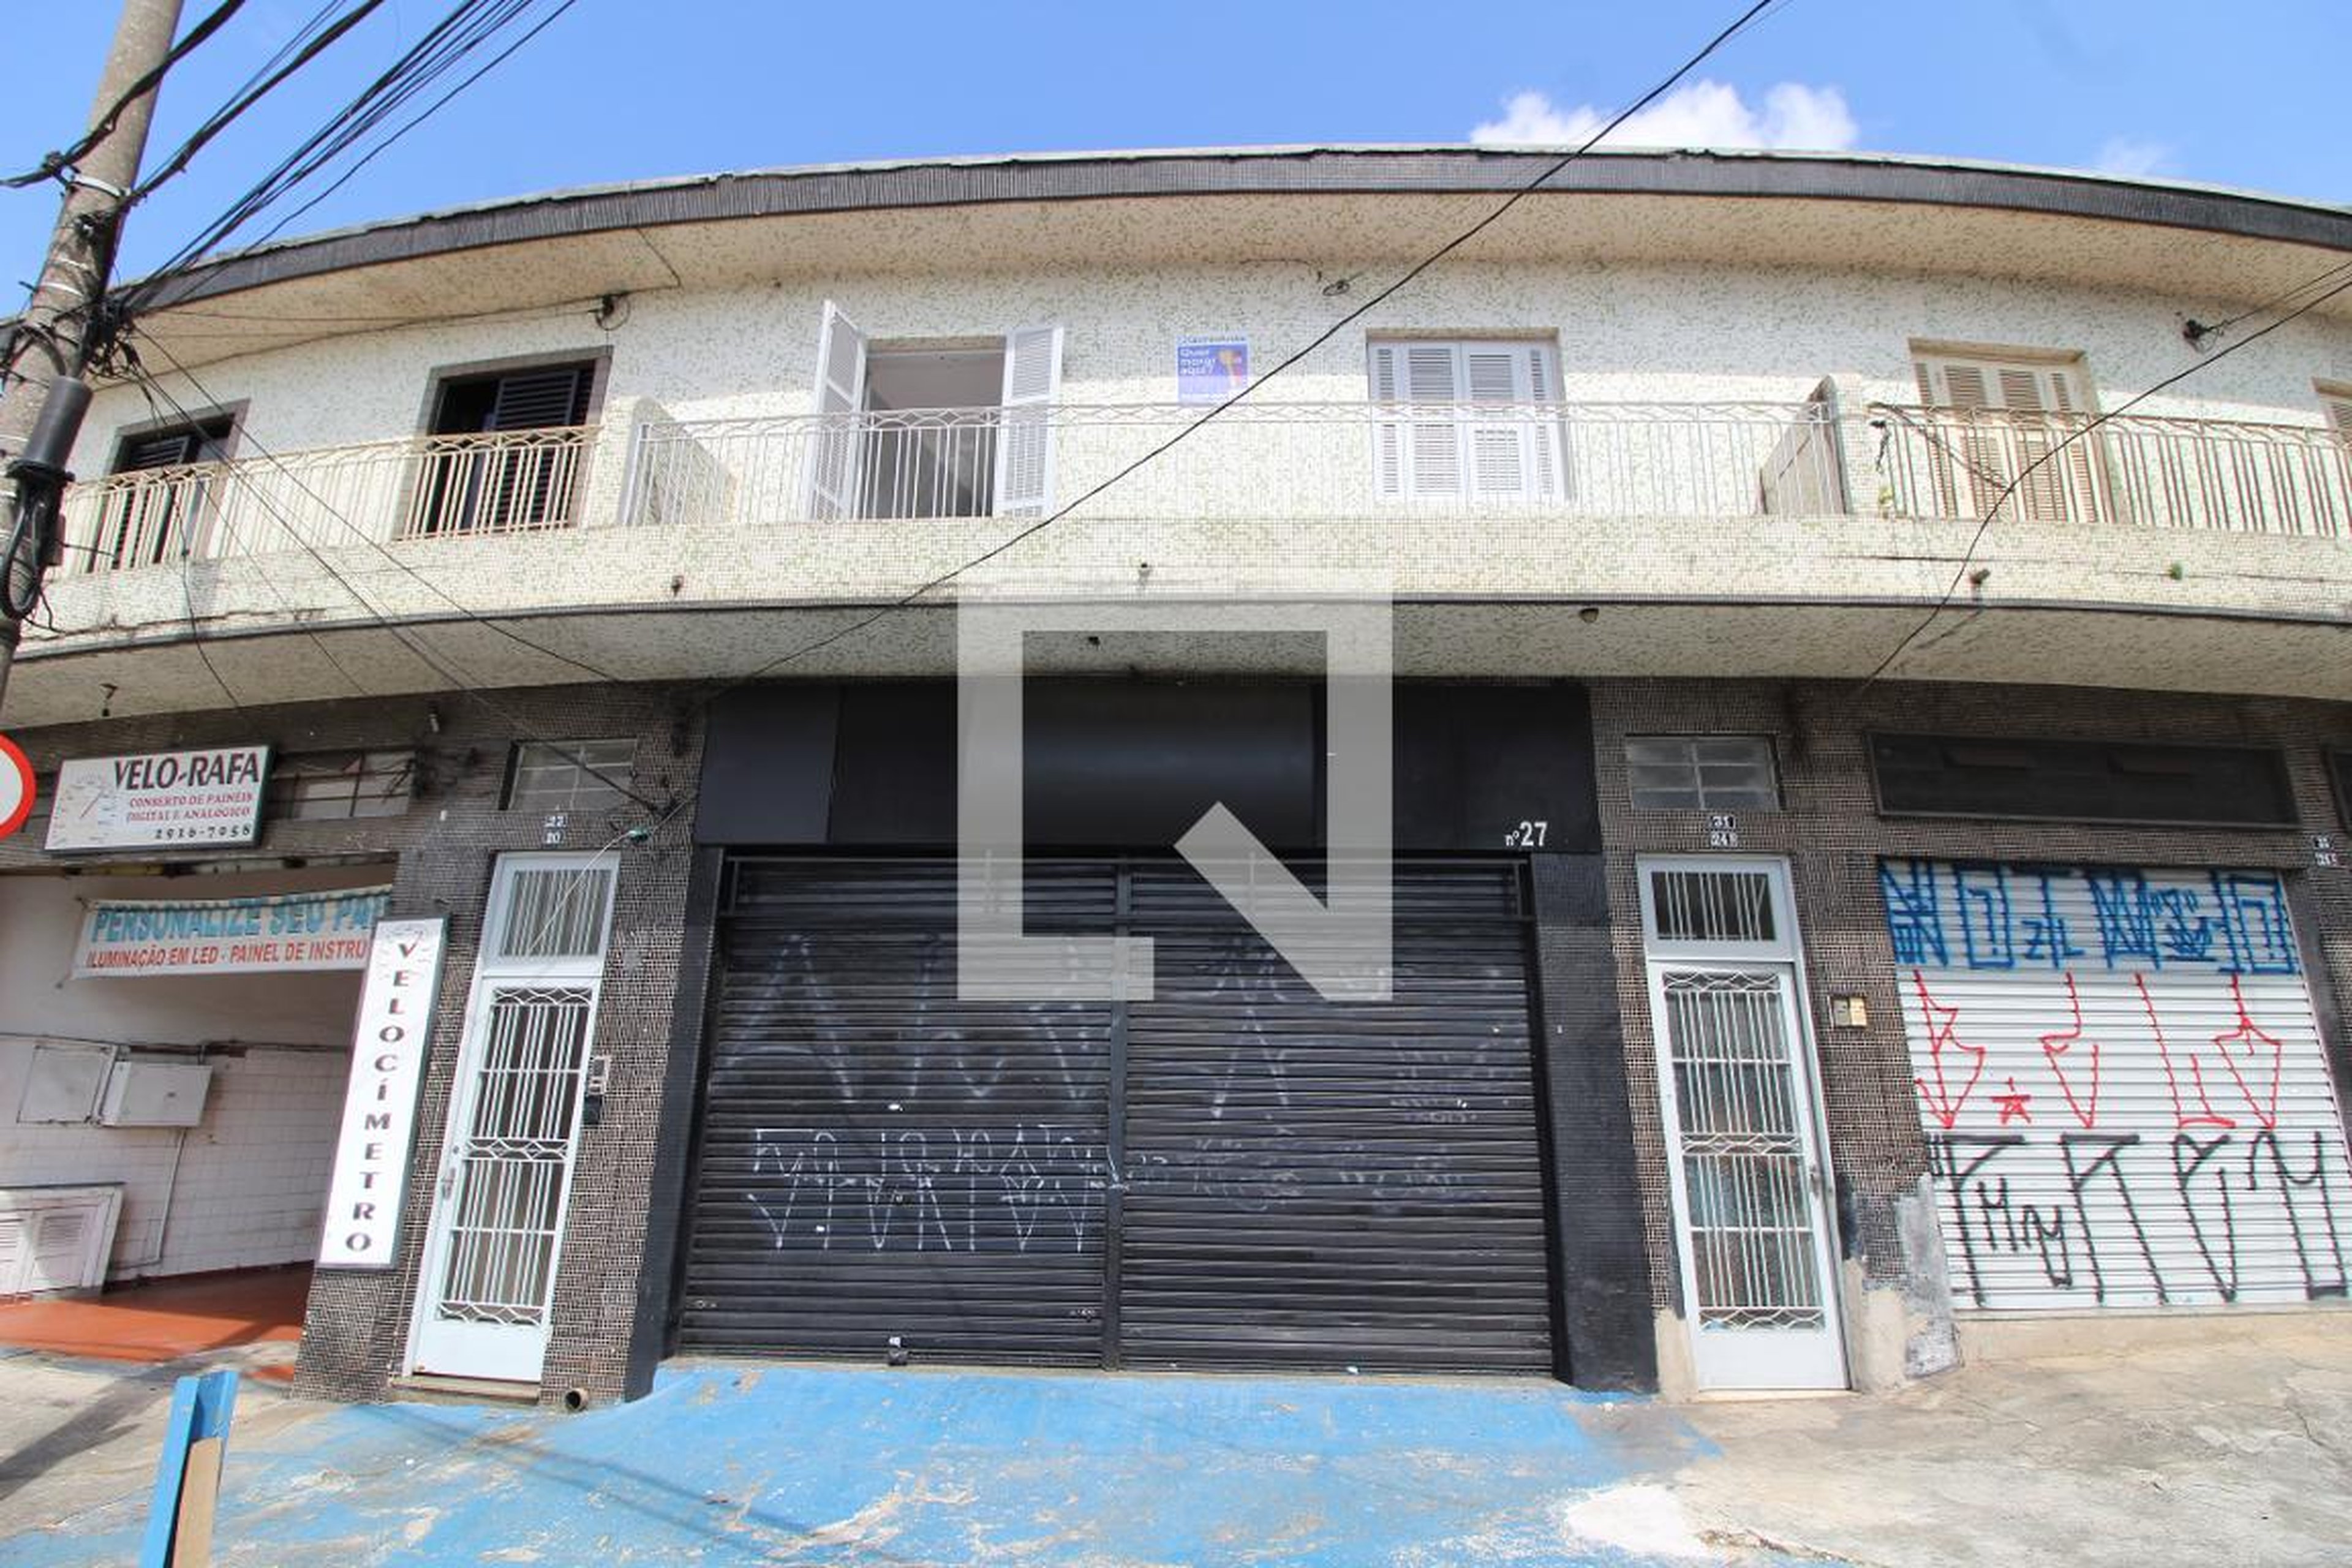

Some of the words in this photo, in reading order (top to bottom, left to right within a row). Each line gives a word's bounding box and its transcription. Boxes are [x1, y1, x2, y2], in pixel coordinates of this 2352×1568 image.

[115, 751, 260, 791] VELO-RAFA
[130, 796, 186, 808] CONSERTO
[189, 794, 205, 805] DE
[91, 899, 262, 943] PERSONALIZE
[270, 895, 327, 935] SEU
[86, 944, 166, 970] ILUMINAÇÃO
[167, 947, 189, 966] EM
[192, 946, 219, 965] LED
[229, 940, 279, 964] PAINEL
[285, 940, 306, 962] DE
